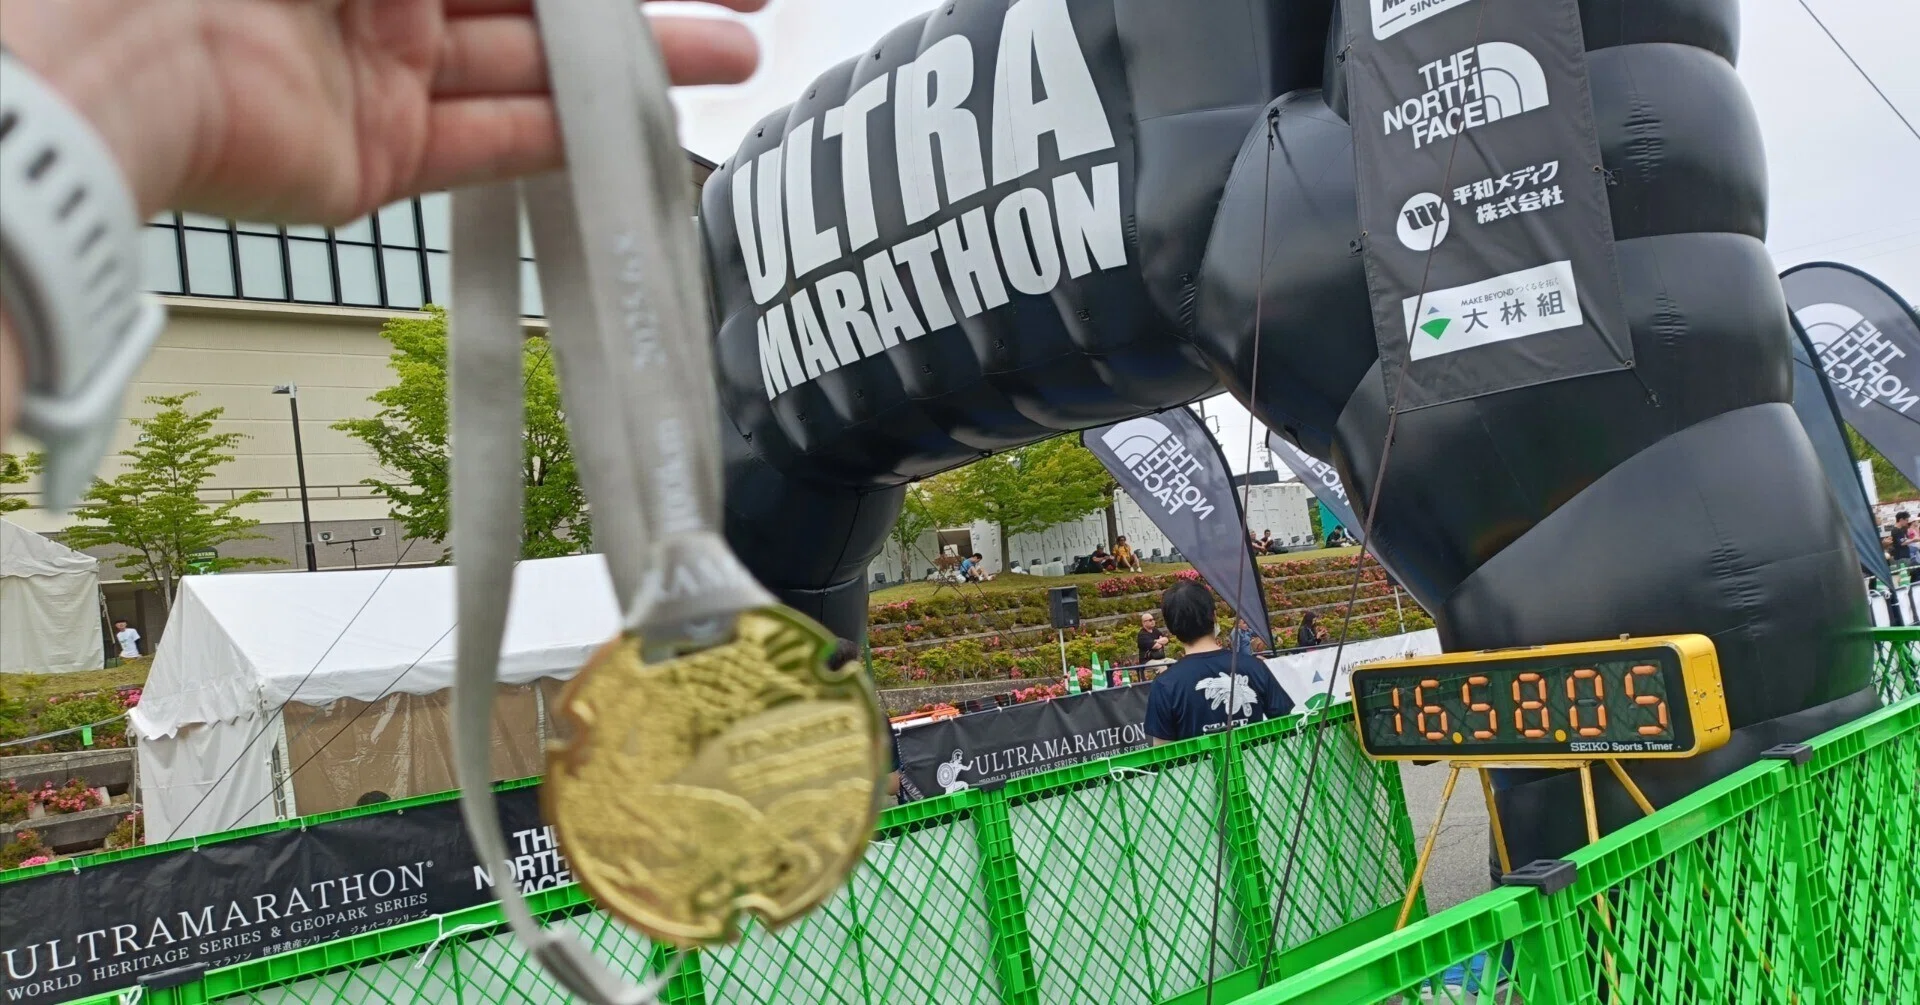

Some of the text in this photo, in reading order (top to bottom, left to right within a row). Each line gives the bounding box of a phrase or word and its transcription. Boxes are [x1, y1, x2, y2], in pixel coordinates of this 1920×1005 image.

[1418, 47, 1477, 91] THE
[1382, 73, 1482, 135] NORTH
[1412, 100, 1485, 149] FACE
[732, 0, 1115, 305] ULTRA
[1453, 160, 1558, 205] 平和メディク
[1476, 185, 1564, 224] 株式会社
[757, 161, 1128, 401] MARATHON
[1461, 295, 1483, 306] MAKE
[1484, 288, 1514, 302] BEYOND
[1462, 290, 1565, 334] 大林組
[975, 722, 1147, 775] ULTRAMARATHON
[1010, 763, 1051, 778] HERITAGE
[1054, 757, 1077, 768] SERIES
[1124, 743, 1149, 754] SERIES
[1570, 741, 1673, 752] SEIKO Sports Timer
[7, 893, 429, 1002] WORLD HERITAGE SERIES & GEOPARK SERIES
[262, 929, 340, 956] 世界遺産シリーズ
